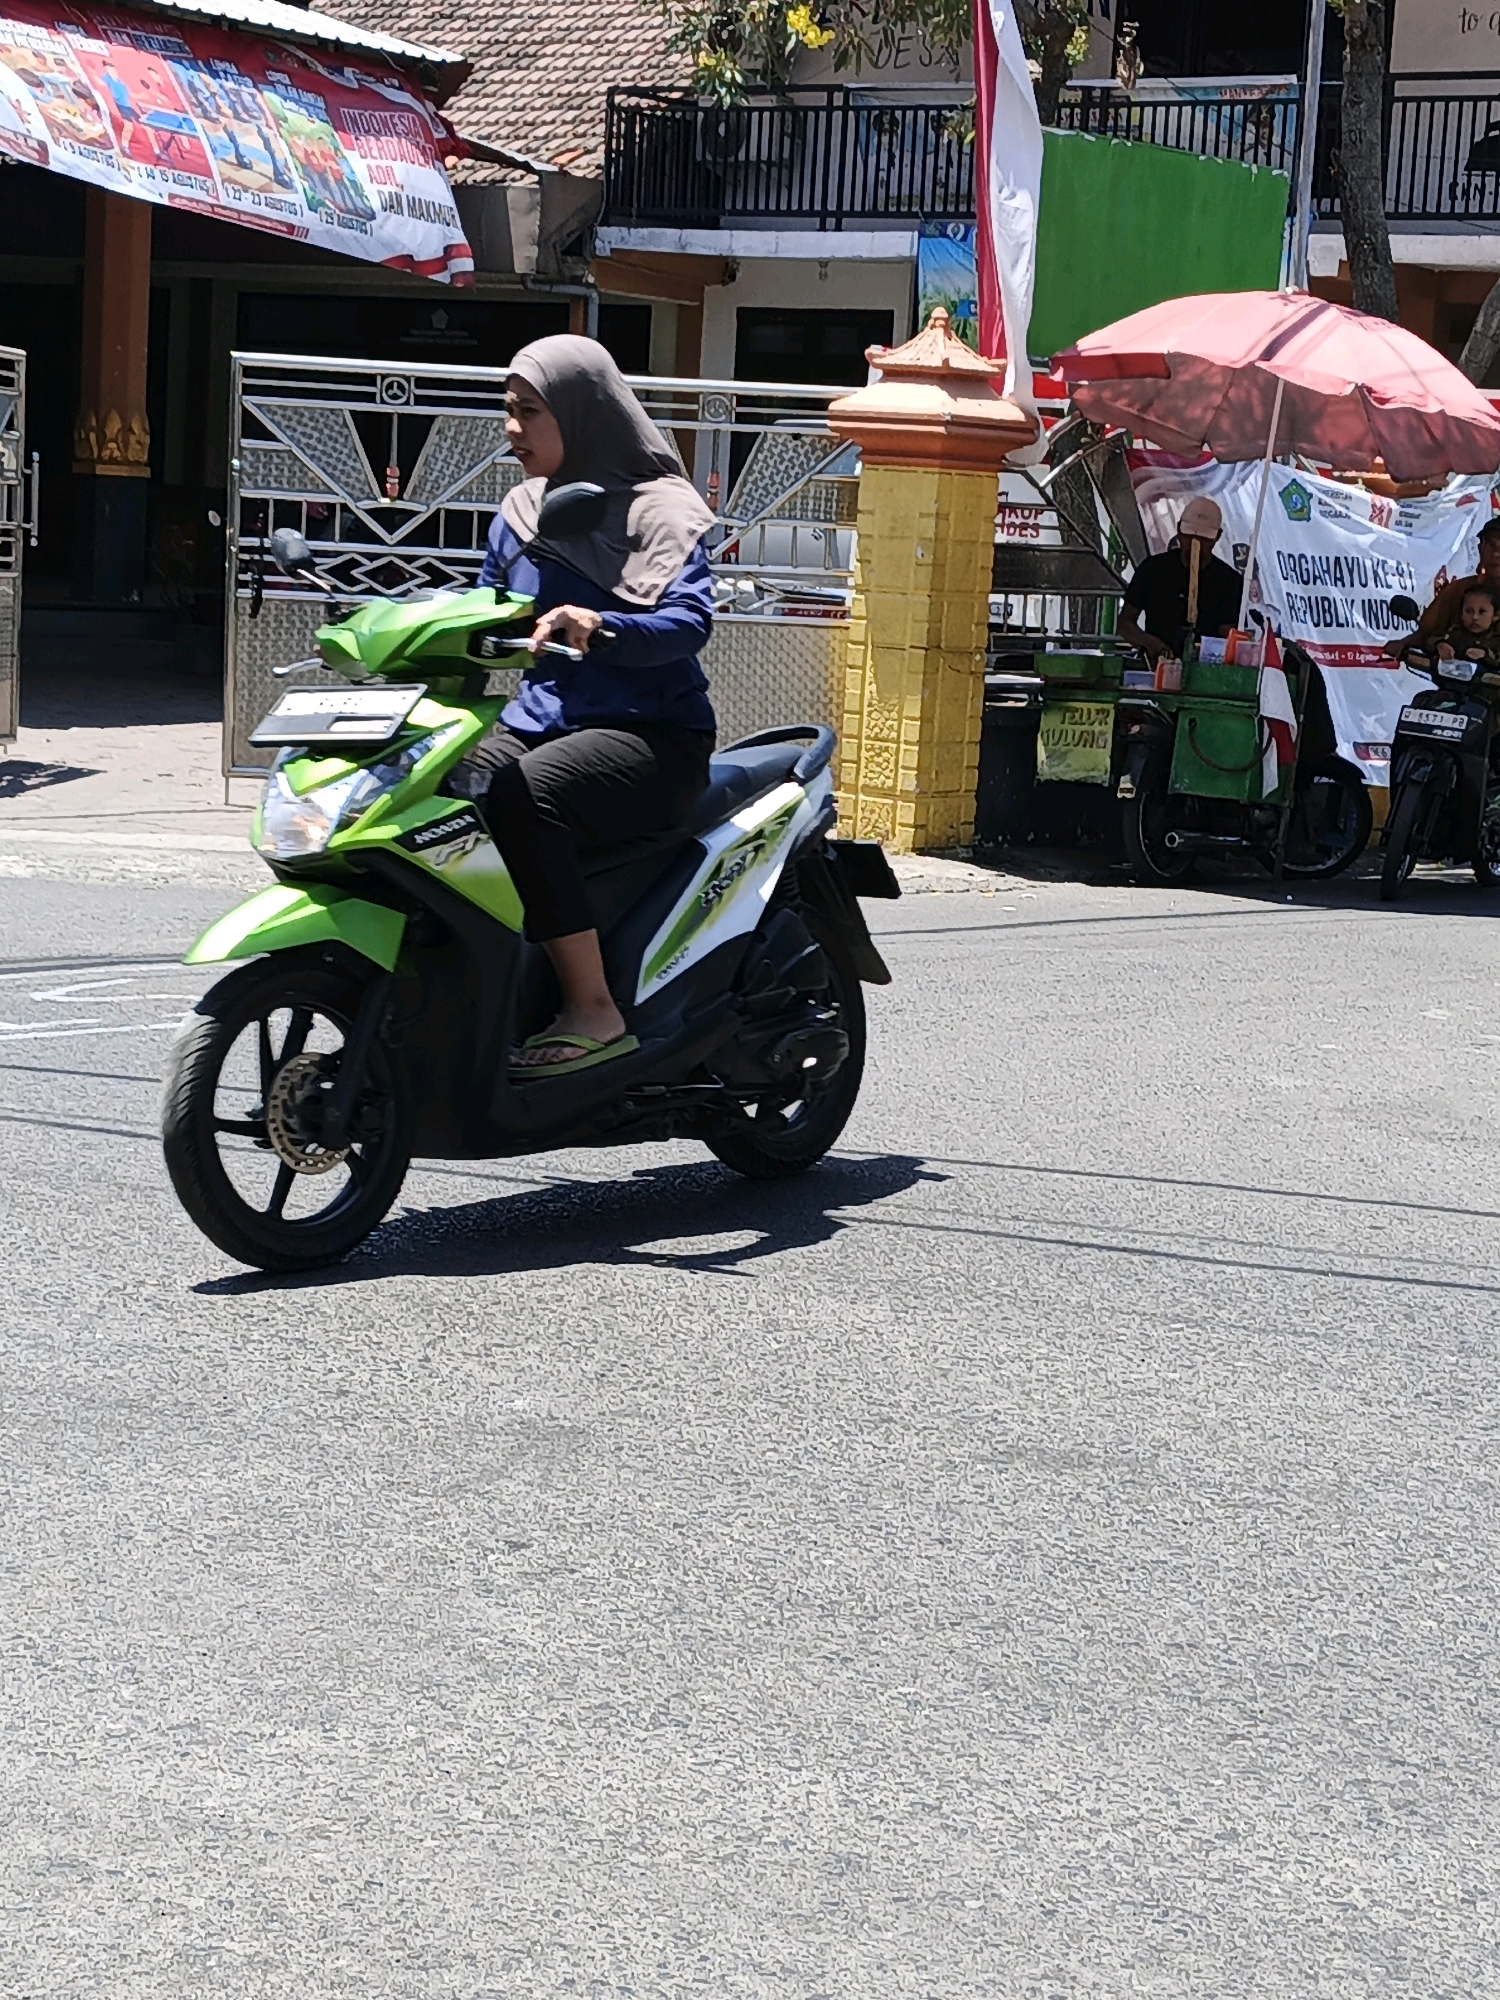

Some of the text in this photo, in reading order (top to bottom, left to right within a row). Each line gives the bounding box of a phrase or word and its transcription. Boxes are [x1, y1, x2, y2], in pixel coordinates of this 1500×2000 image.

[341, 108, 425, 142] INDONESIA
[377, 190, 404, 217] DAN
[1276, 551, 1368, 588] DRGAHAYU
